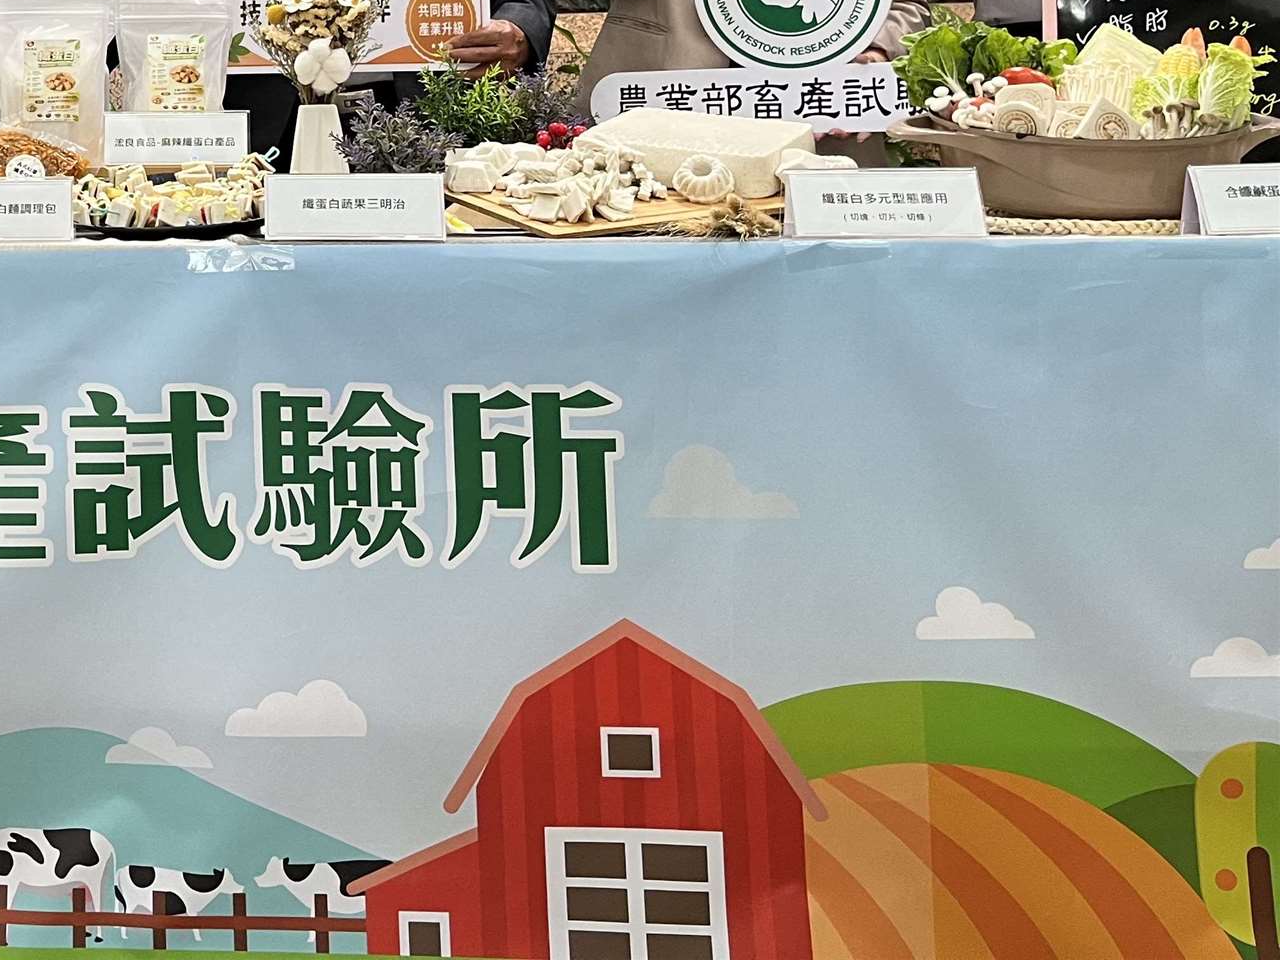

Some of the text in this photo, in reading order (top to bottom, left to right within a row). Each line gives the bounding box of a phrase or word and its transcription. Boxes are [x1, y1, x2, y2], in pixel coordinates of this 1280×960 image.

[418, 2, 464, 17] 共同推動
[419, 21, 464, 36] 產業升級
[1208, 14, 1256, 36] 0.3g
[732, 24, 786, 56] LIVESTOCK
[790, 28, 845, 56] RESEARCH
[302, 198, 405, 209] 纖蛋白蔬果三明治
